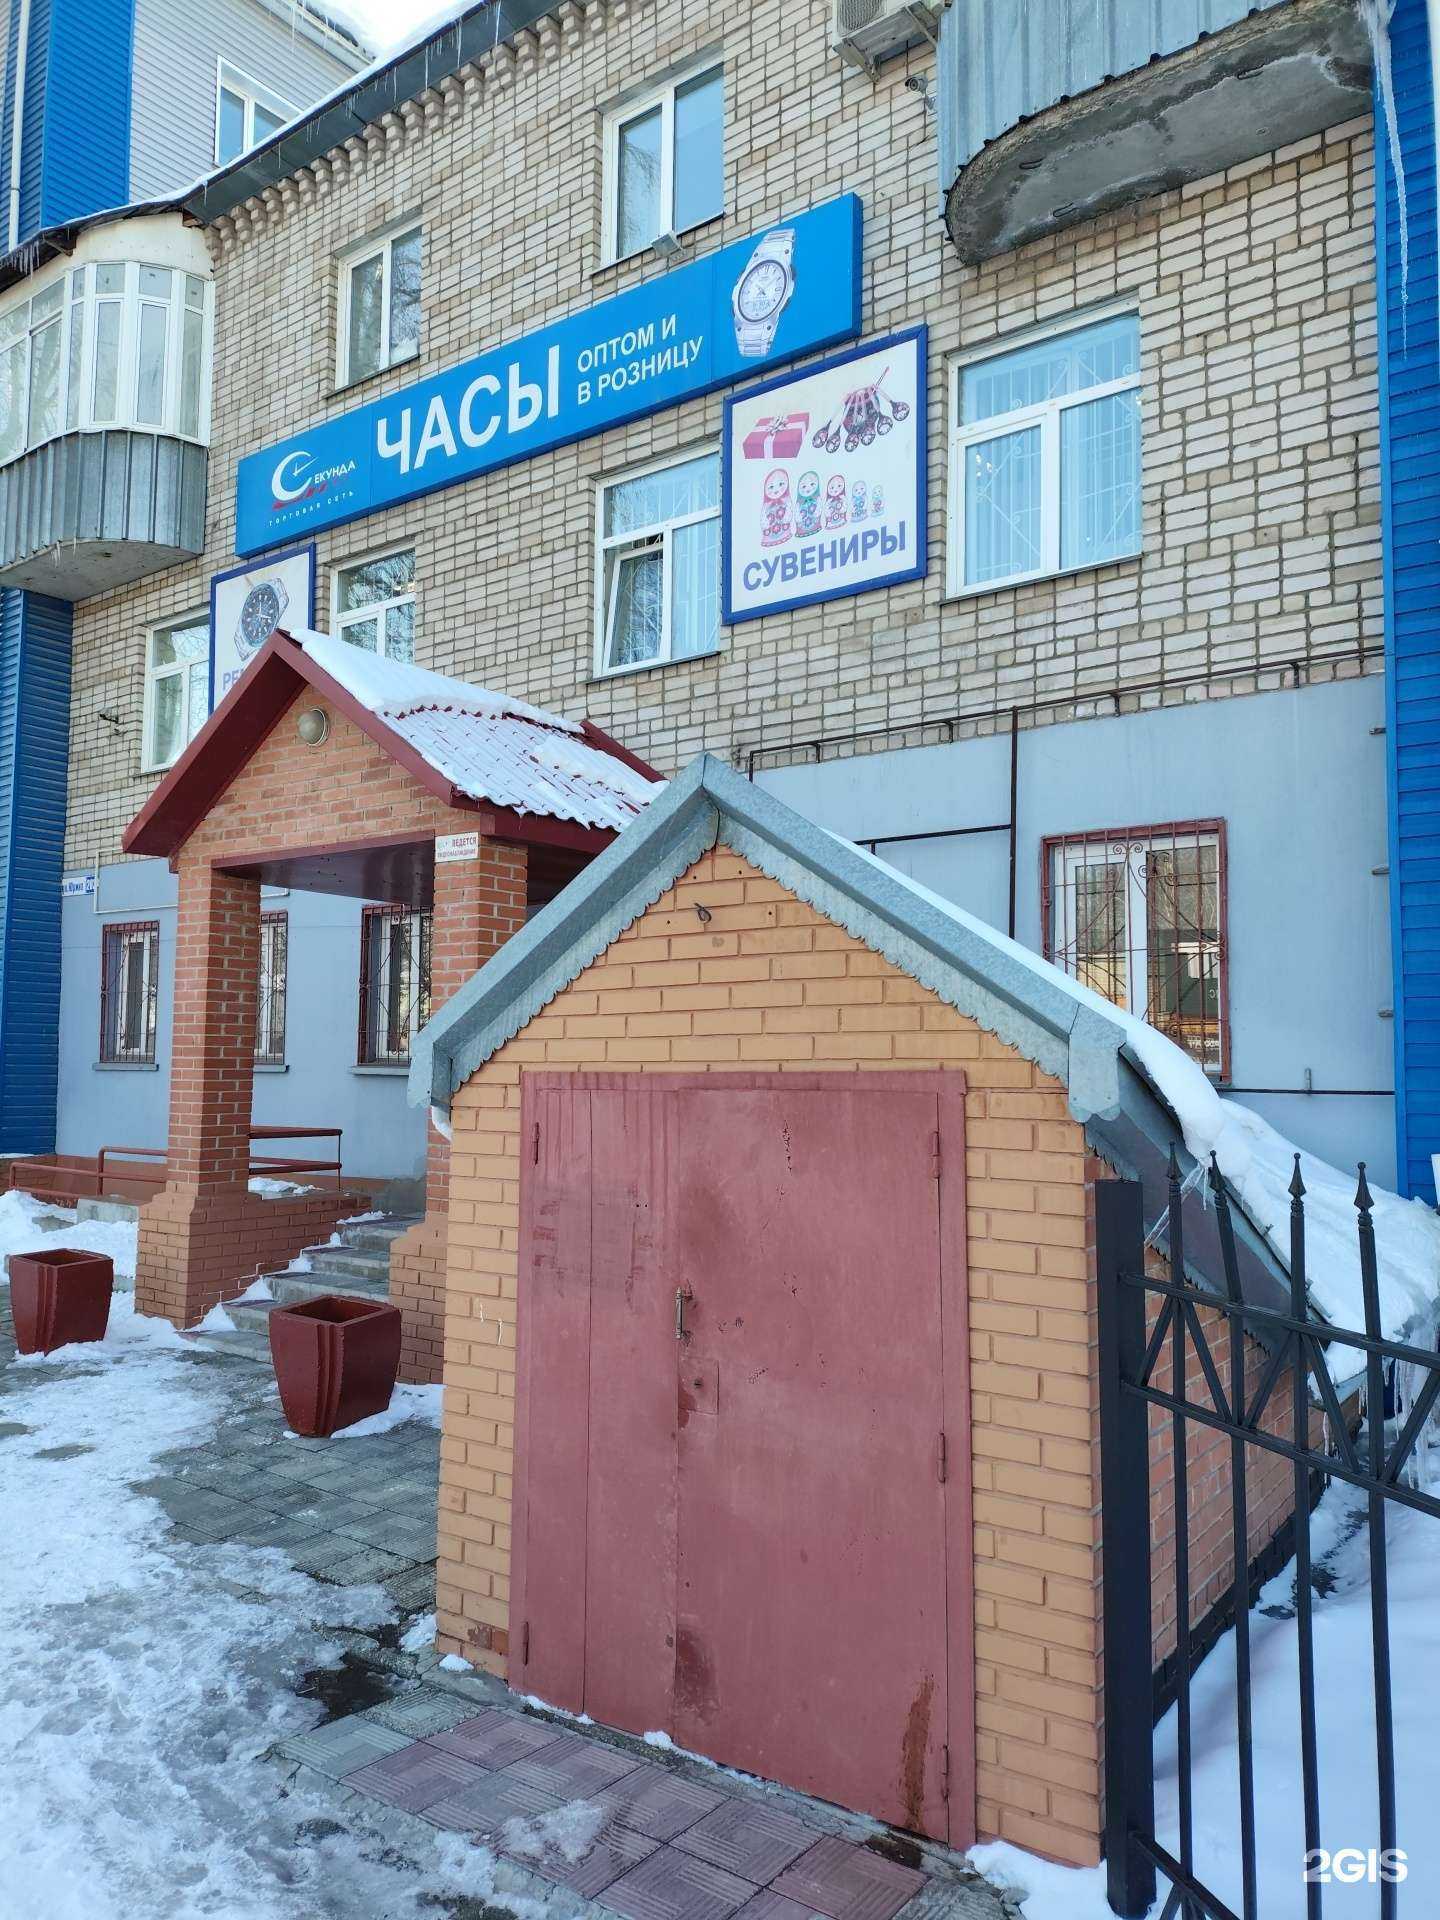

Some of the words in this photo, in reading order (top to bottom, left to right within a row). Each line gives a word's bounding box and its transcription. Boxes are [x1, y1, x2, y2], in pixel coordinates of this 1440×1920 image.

[577, 323, 654, 373] ОПТОМ
[661, 313, 677, 340] И
[577, 381, 591, 405] В
[598, 336, 703, 397] РОЗНИЦУ
[378, 345, 560, 475] ЧАСЫ
[268, 502, 321, 527] ТОРГОВАЯ
[327, 490, 354, 505] СЕТЬ
[743, 520, 906, 591] СУВЕНИРЫ
